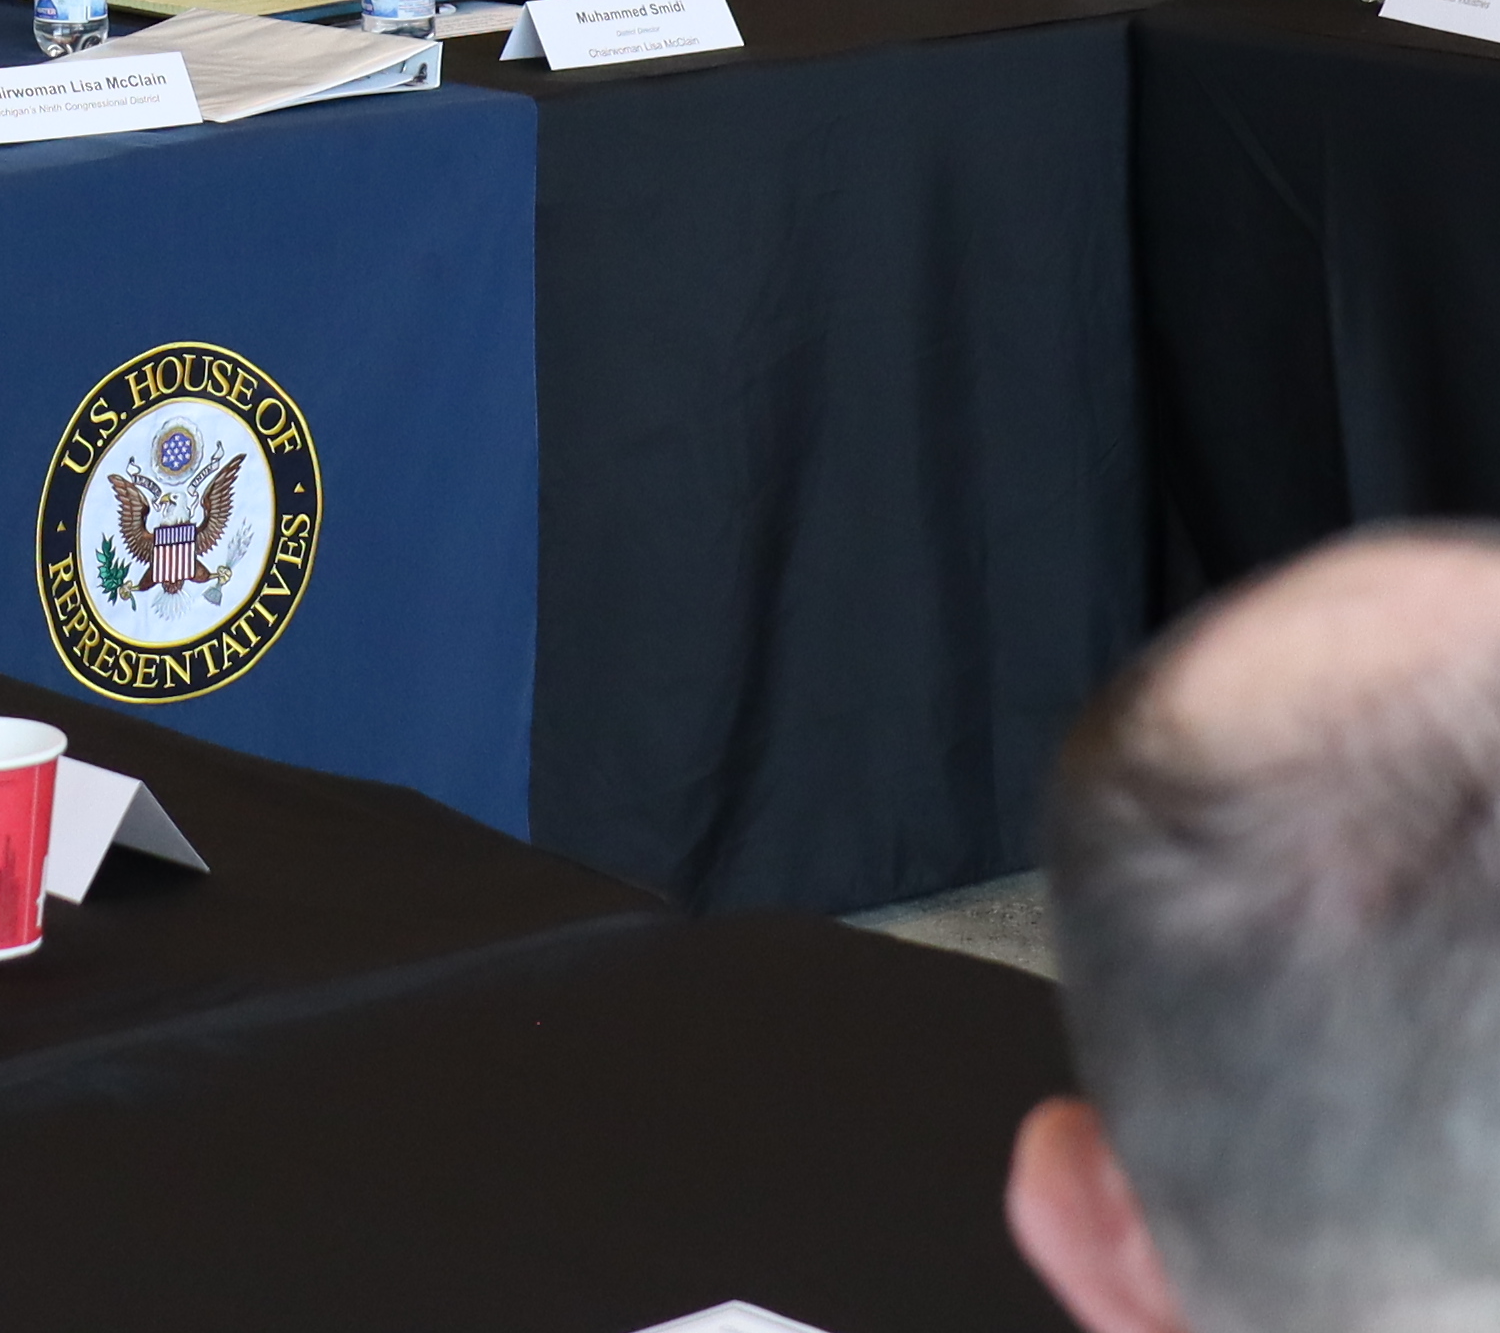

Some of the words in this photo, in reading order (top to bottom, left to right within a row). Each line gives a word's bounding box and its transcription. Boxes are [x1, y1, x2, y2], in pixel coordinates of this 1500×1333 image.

[575, 4, 648, 24] Muhammed
[648, 0, 685, 16] Smidi
[588, 43, 643, 59] Chairwoman
[644, 41, 663, 52] Lisa
[663, 36, 700, 49] McClain
[69, 79, 104, 94] Lisa
[105, 72, 168, 90] McClain
[38, 102, 63, 113] Ninth
[64, 97, 129, 113] Congressional
[129, 93, 161, 105] District
[60, 396, 128, 476] U.S.
[125, 353, 258, 411] HOUSE
[255, 398, 303, 454] OF
[48, 512, 311, 690] REPRESENTATIVES
